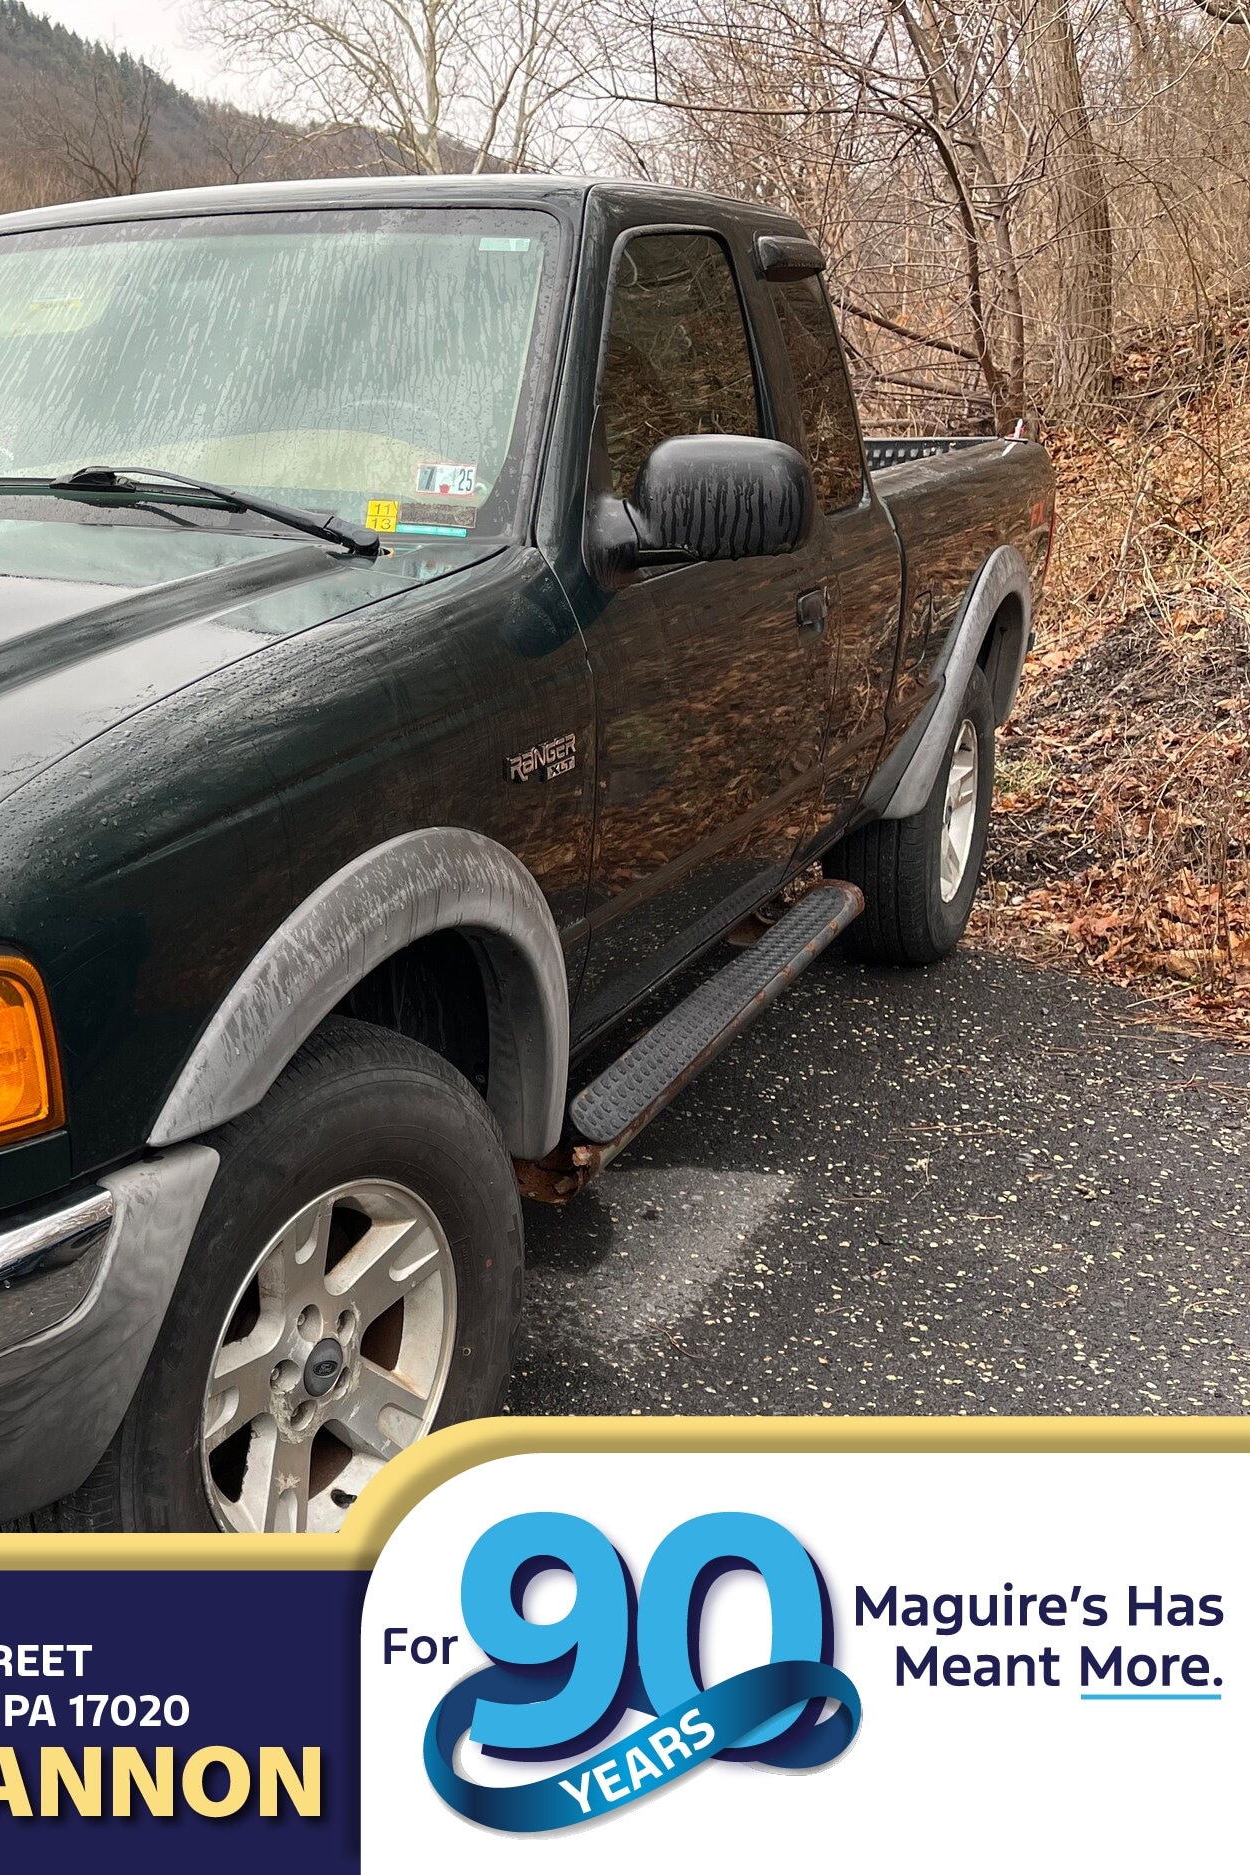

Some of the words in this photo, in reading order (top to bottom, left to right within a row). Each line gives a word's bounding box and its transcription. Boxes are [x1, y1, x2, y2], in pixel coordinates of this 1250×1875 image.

[458, 468, 473, 492] 25
[374, 503, 391, 515] 11
[371, 518, 392, 530] 13
[509, 733, 576, 782] RANGER
[550, 758, 573, 777] XLT
